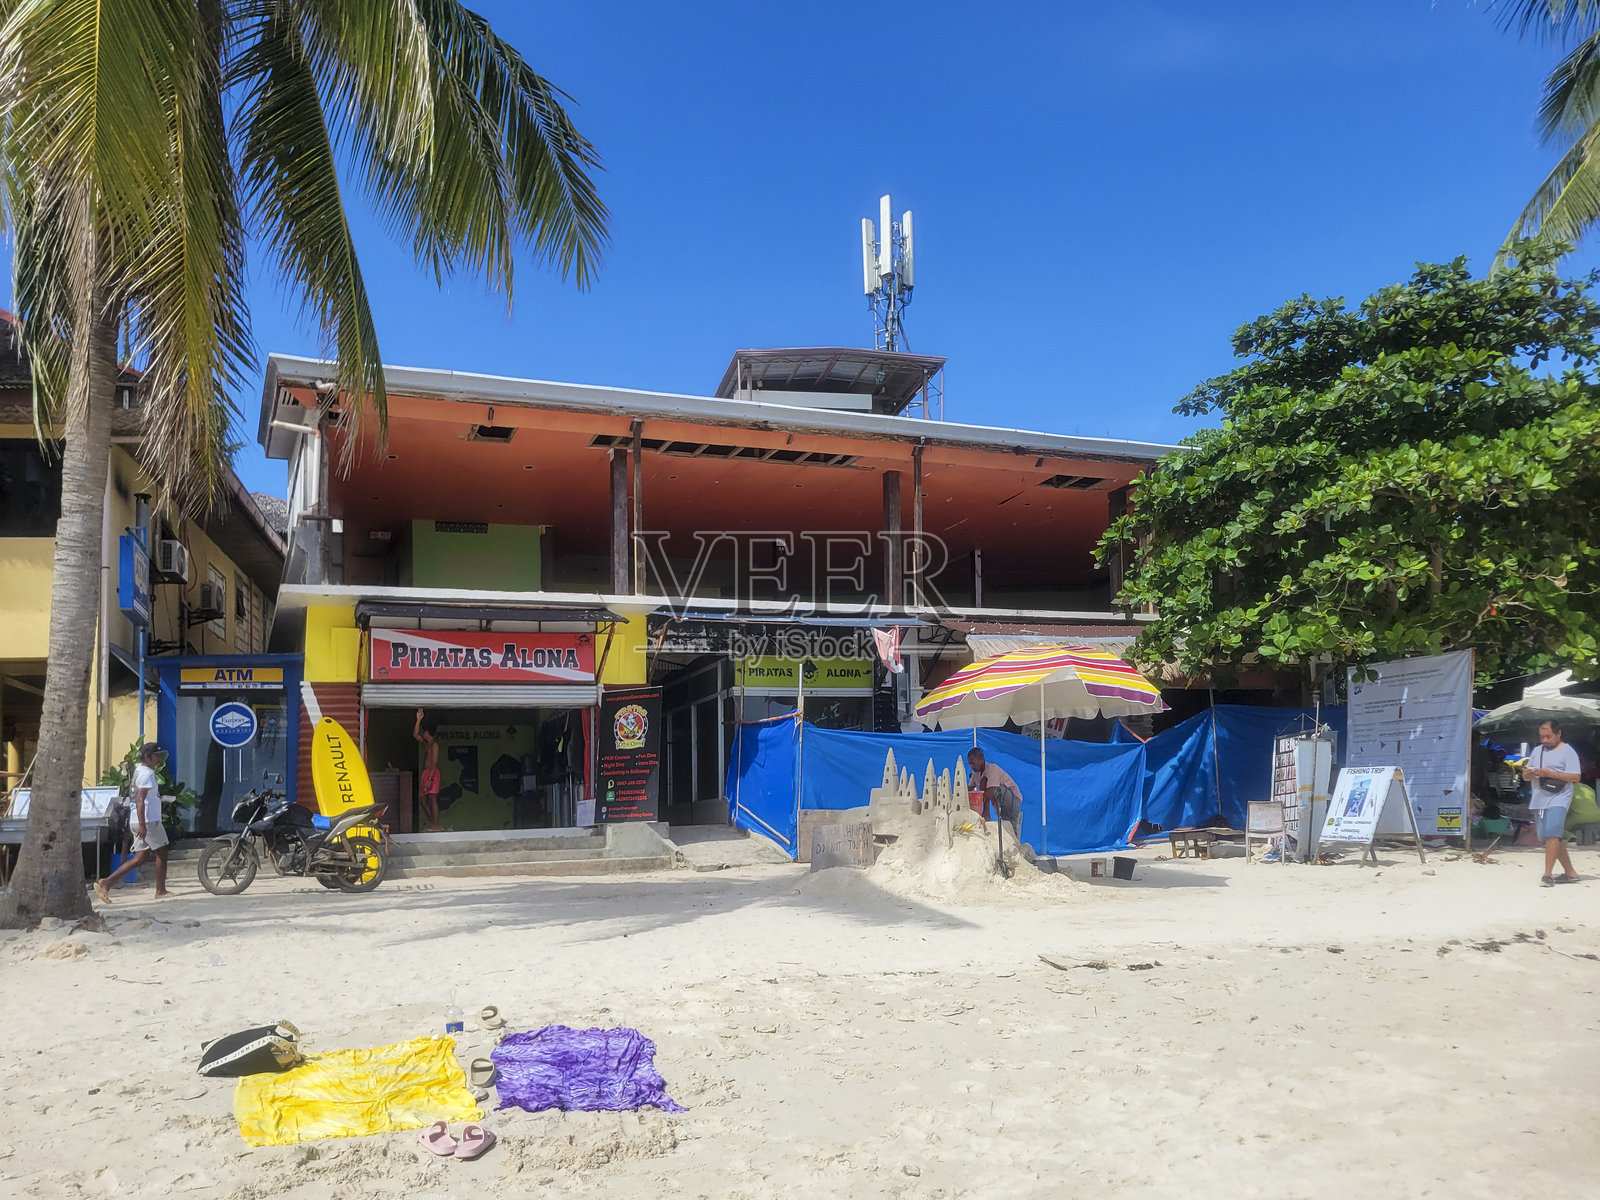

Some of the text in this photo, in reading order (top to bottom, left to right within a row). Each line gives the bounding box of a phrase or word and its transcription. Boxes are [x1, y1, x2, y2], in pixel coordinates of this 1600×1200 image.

[390, 642, 580, 668] PIRATAS ALONA
[214, 669, 253, 681] ATM
[748, 667, 861, 678] PIRATAS ALONA
[473, 730, 501, 740] ALONA
[326, 733, 356, 804] RENAULT
